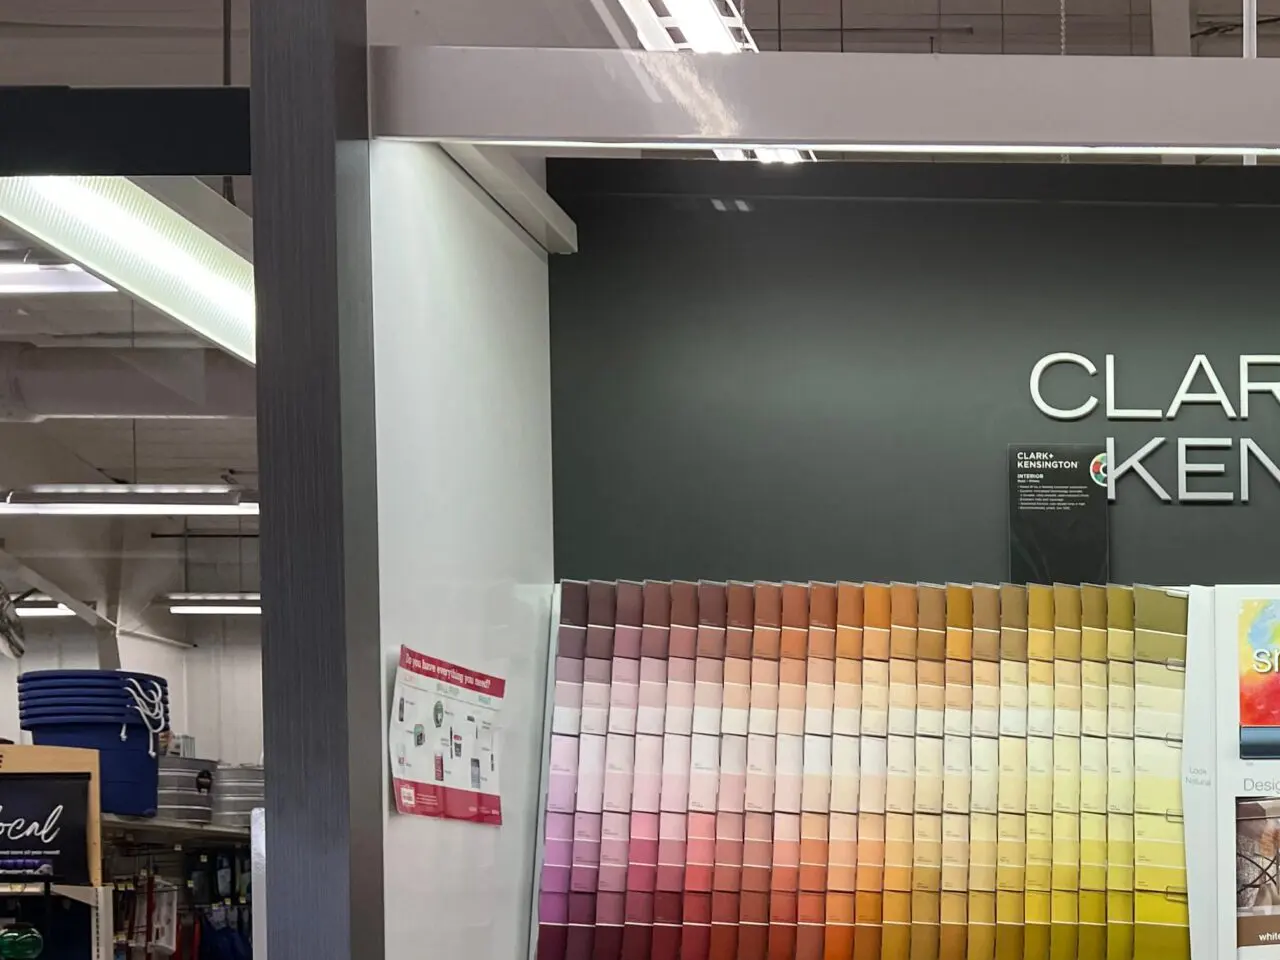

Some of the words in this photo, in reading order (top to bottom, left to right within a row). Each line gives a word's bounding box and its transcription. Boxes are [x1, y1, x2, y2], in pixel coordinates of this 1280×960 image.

[1017, 461, 1079, 469] KENSINGTON
[422, 658, 436, 673] have
[437, 663, 464, 684] everything
[464, 674, 474, 685] you
[0, 804, 64, 844] ocal
